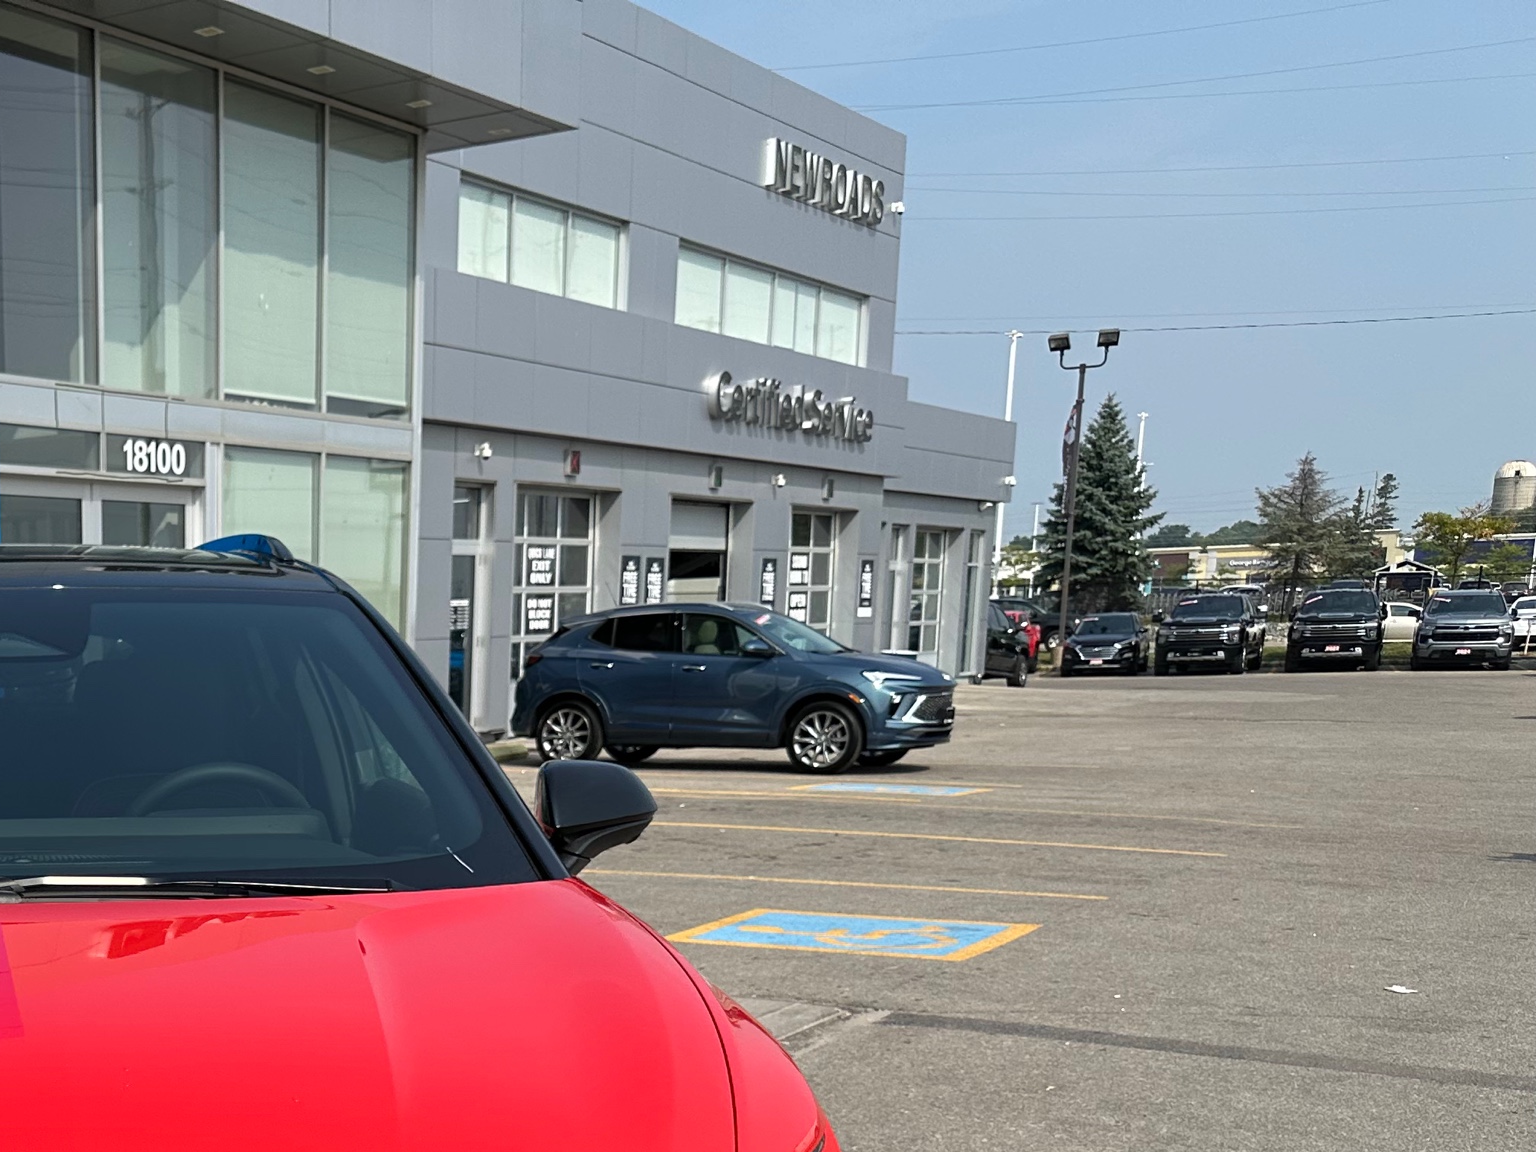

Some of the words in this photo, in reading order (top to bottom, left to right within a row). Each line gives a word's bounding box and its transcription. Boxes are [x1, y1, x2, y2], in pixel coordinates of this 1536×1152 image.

[765, 137, 884, 226] NEWROADS
[704, 371, 805, 432] Certified
[803, 389, 874, 443] Service
[123, 438, 186, 475] 18100
[529, 572, 552, 584] ONLY
[532, 560, 551, 571] EXIT
